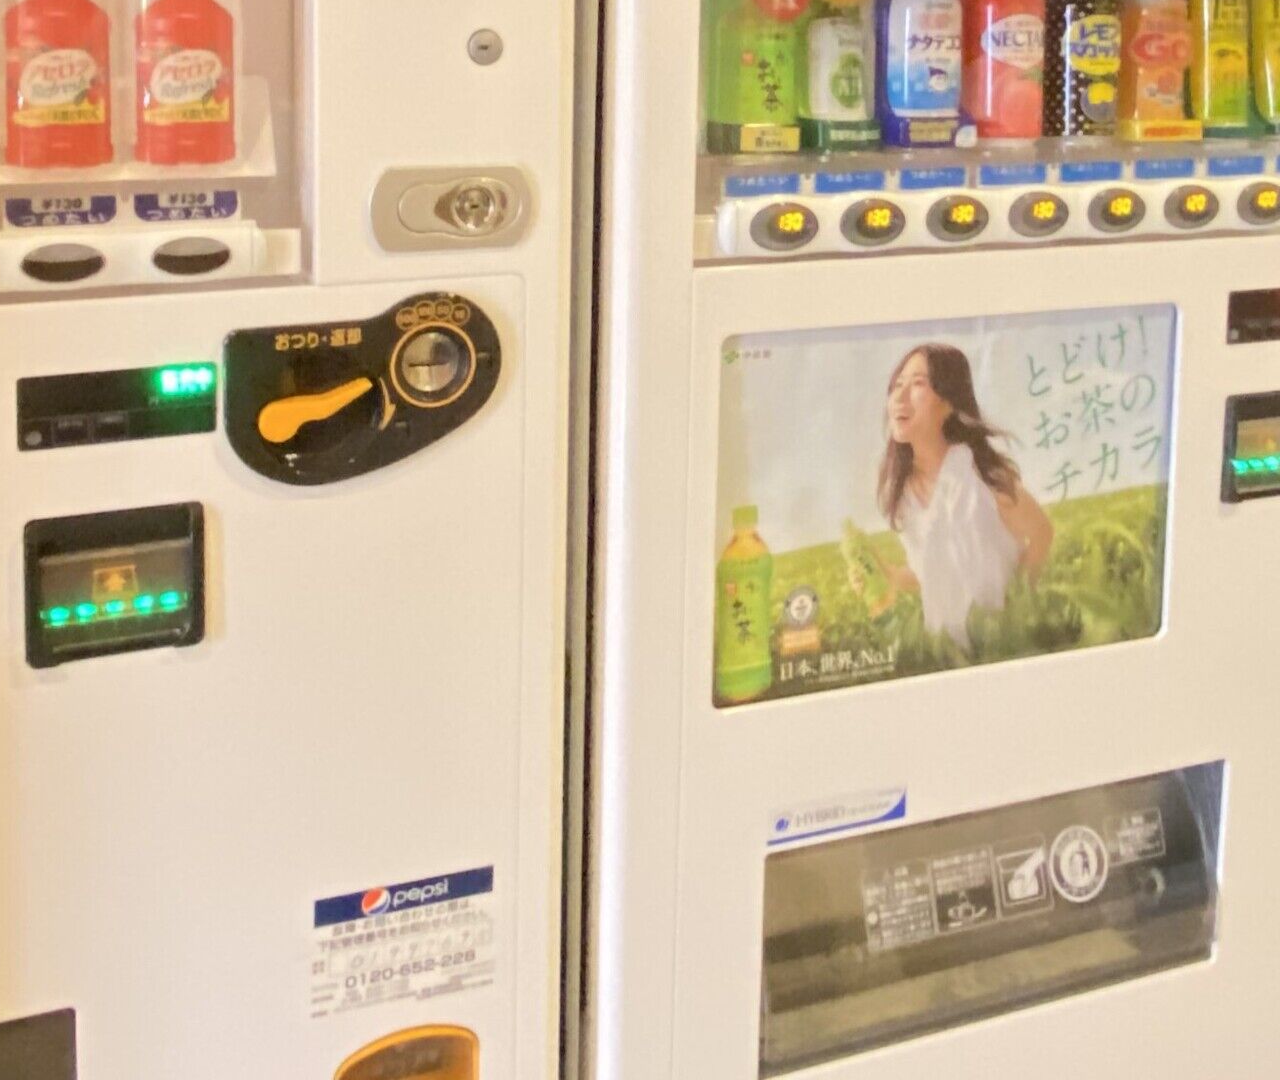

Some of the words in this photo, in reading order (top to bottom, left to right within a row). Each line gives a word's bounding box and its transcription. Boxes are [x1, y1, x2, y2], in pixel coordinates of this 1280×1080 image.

[1027, 315, 1149, 398] とどけ!
[1034, 374, 1157, 450] お茶の
[1044, 426, 1162, 503] チカラ
[392, 878, 450, 908] pepsi
